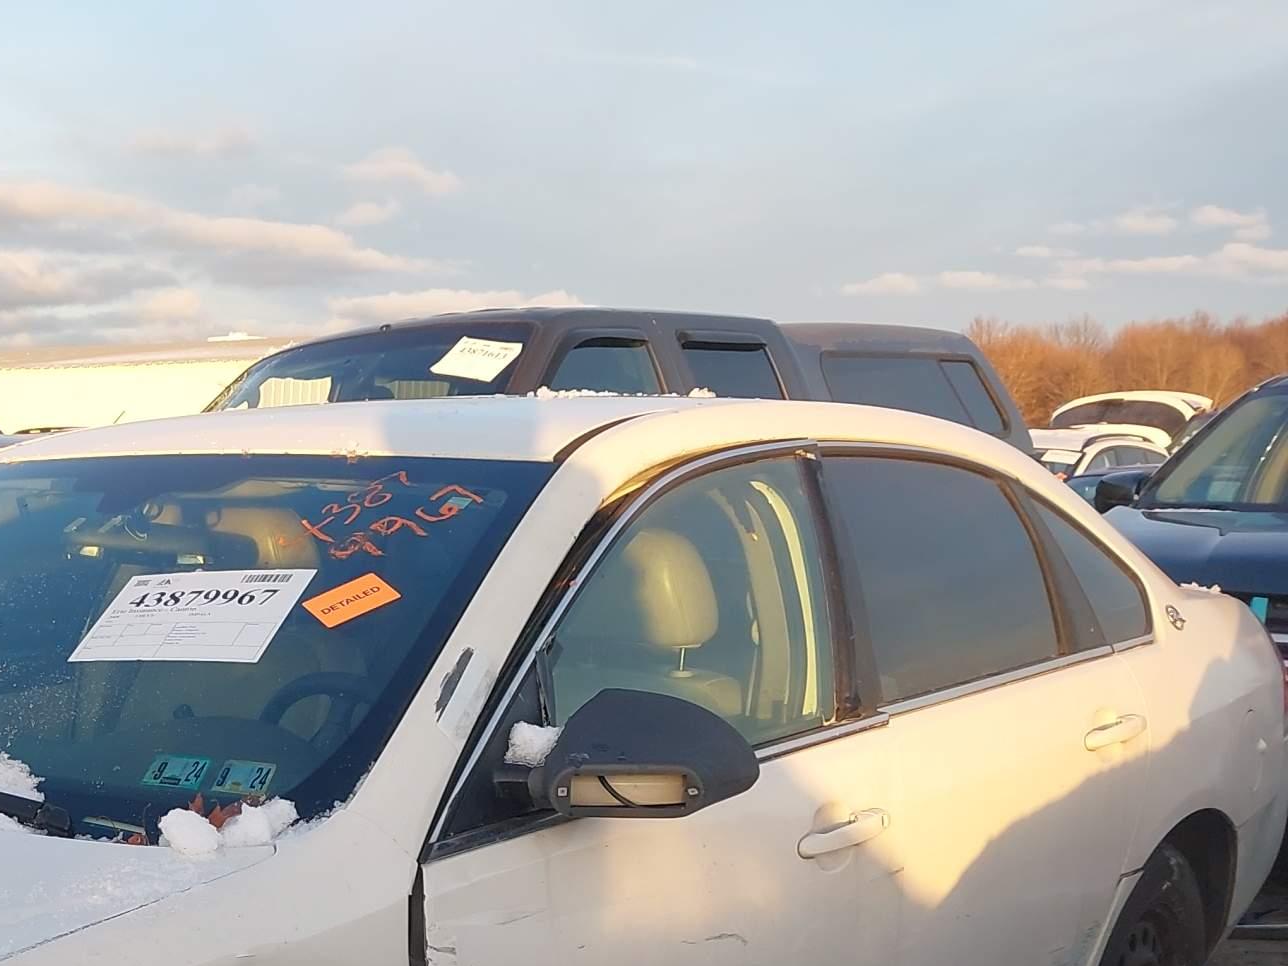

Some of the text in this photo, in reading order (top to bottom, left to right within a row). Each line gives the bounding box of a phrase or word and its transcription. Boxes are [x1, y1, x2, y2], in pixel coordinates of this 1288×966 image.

[128, 588, 280, 608] 43879967
[320, 585, 381, 616] DETAILED
[183, 761, 207, 782] 24
[249, 767, 271, 790] 24
